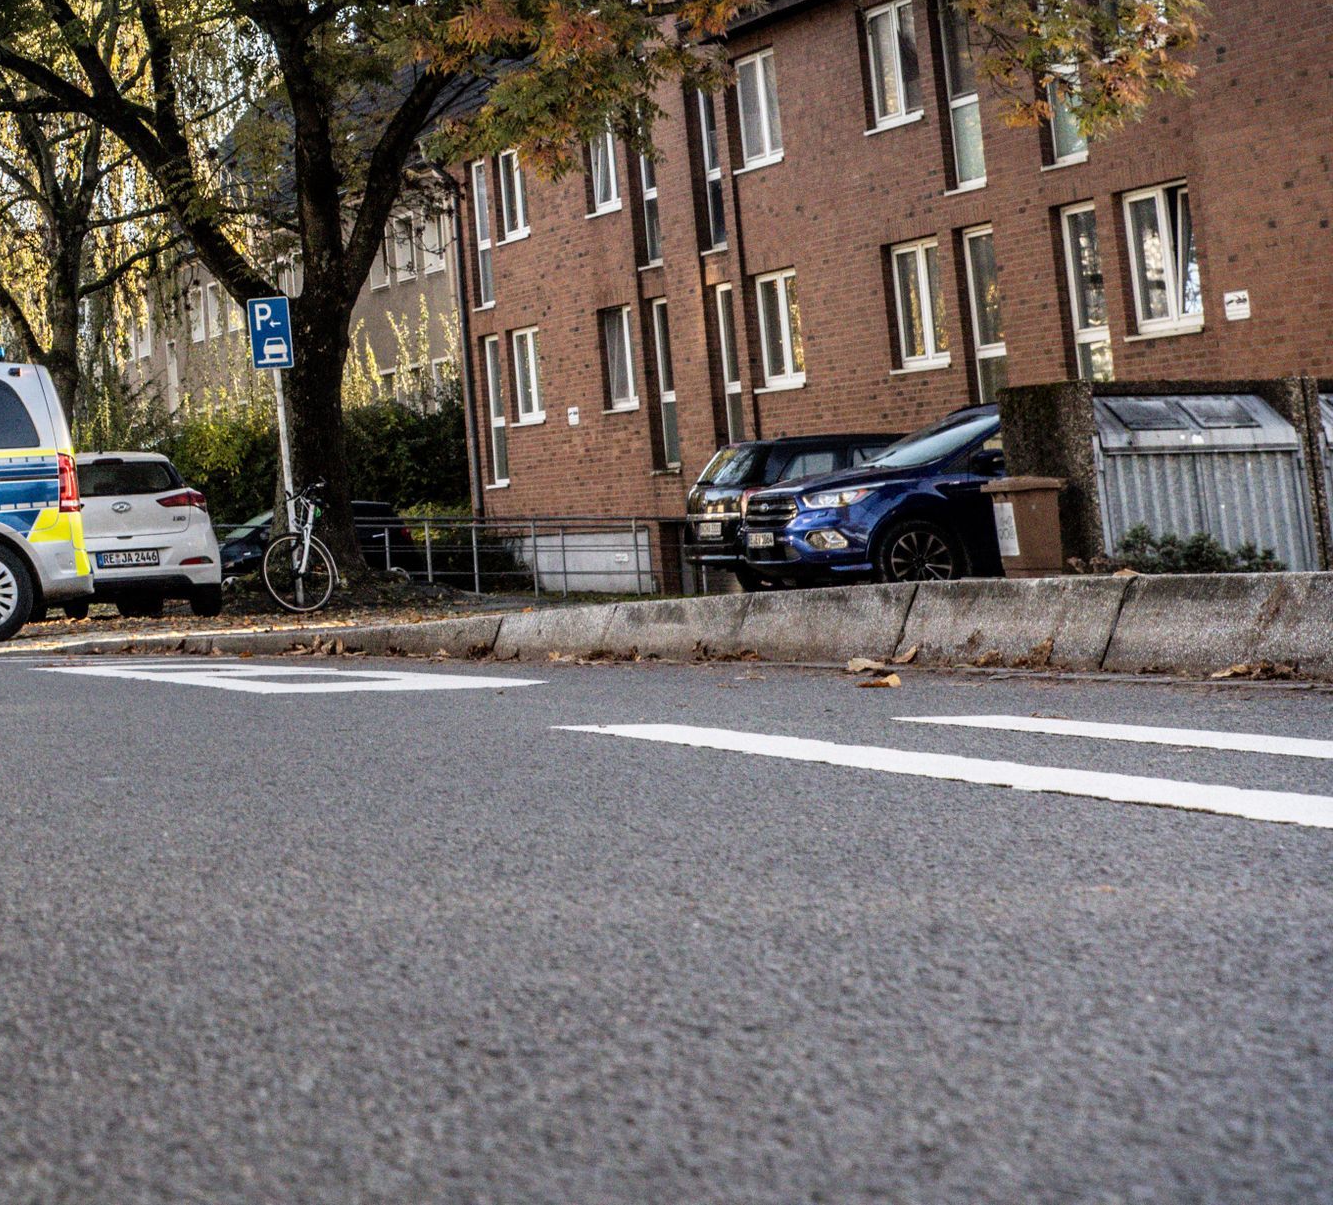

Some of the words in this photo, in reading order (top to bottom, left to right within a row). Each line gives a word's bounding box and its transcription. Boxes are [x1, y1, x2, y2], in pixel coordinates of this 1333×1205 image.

[254, 303, 272, 331] P
[103, 554, 115, 563] RE
[122, 553, 133, 563] JA
[134, 552, 157, 562] 2446
